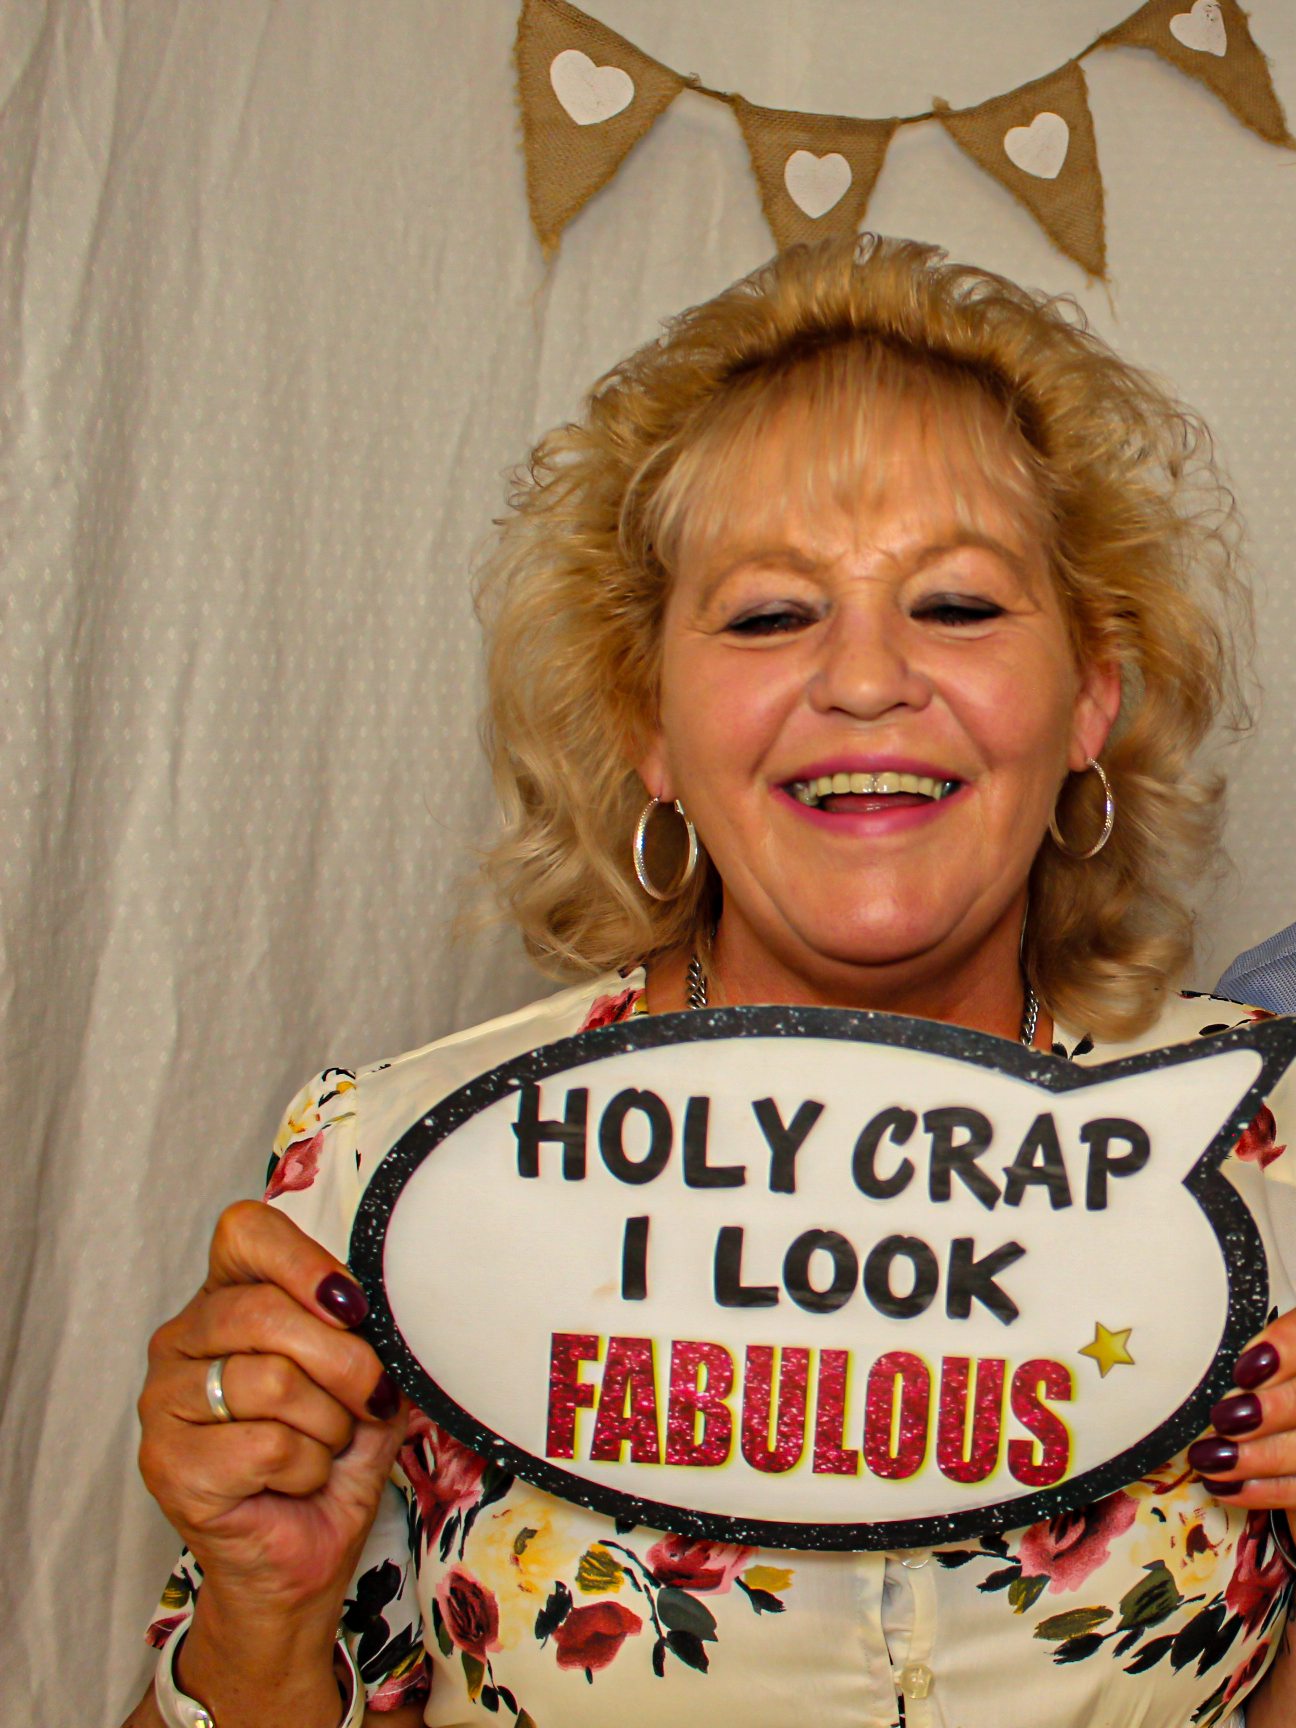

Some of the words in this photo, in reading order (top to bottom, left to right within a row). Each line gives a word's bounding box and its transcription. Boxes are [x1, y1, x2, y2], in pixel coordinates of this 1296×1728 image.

[512, 1084, 824, 1194] HOLY
[851, 1105, 1151, 1211] CRAP
[621, 1216, 649, 1300] I
[714, 1226, 1026, 1325] LOOK
[545, 1332, 1073, 1487] FABULOUS
